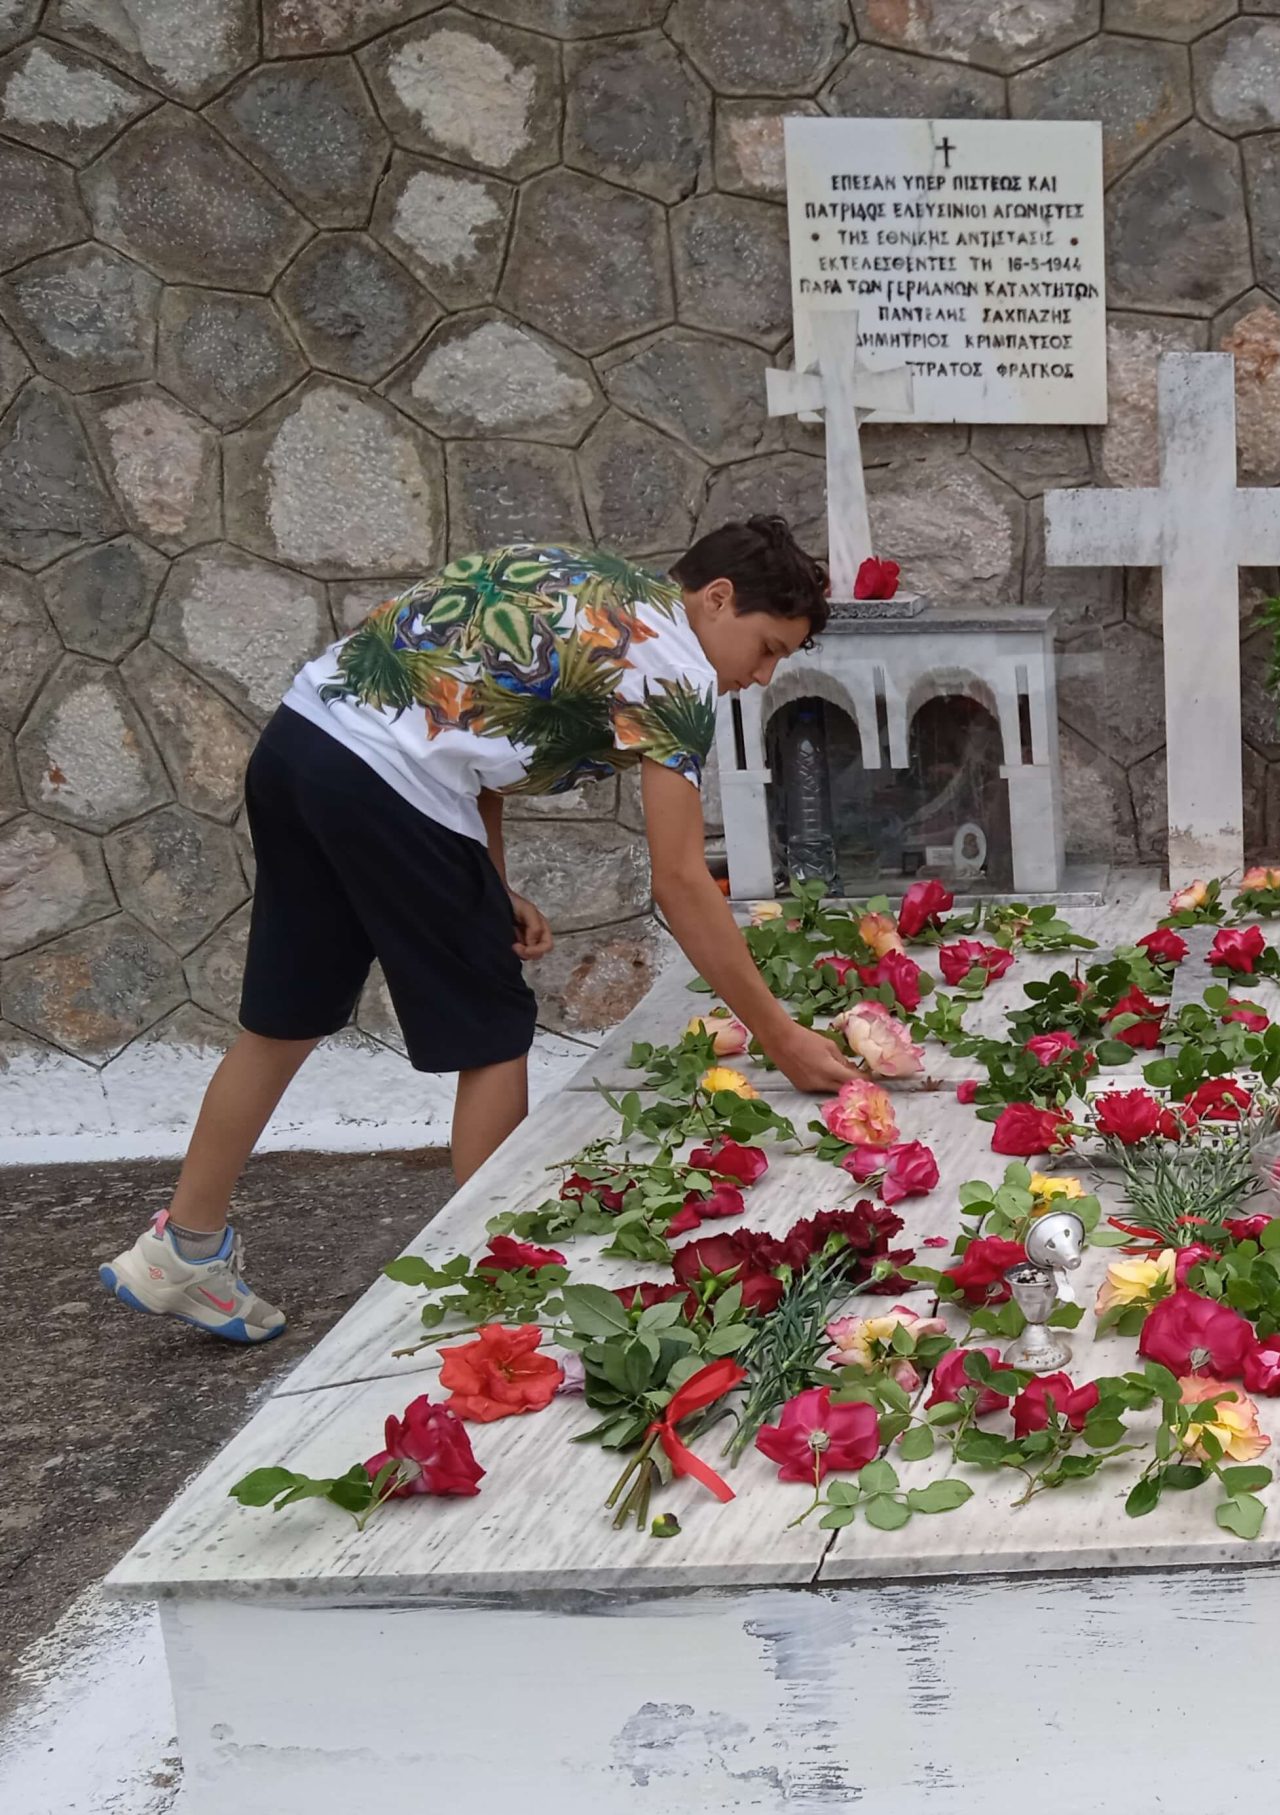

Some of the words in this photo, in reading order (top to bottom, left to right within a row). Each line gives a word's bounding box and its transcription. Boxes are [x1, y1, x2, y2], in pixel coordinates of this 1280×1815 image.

[831, 175, 896, 192] ΕΠΕΣΑΝ
[903, 175, 945, 191] ΥΠΕΡ
[953, 175, 1022, 191] ΠΙΣΤΕΩΣ
[1028, 176, 1057, 191] ΚΑΙ
[805, 203, 885, 222] ΠΑΤΡΙΔΟΣ
[893, 203, 987, 219] ΕΛΕΥΣΙΝΙΟΙ
[993, 204, 1084, 219] ΑΓΩΝΙΣΤΕΣ
[838, 230, 869, 246] ΤΗΣ
[877, 231, 950, 247] ΕΘΝΙΚΗΣ
[819, 257, 957, 272] ΕΚΤΕΛΕΣΘΕΝΤΕΣ
[970, 256, 992, 271] ΤΗ
[1008, 257, 1082, 272] 16-5-1944
[800, 279, 842, 295] ΠΑΡΑ
[847, 280, 882, 294] ΤΩΝ
[887, 280, 979, 302] ΓΕΡΜΑΝΩΝ
[879, 306, 966, 323] ΠΑΝΤΕΛΗΣ
[982, 308, 1072, 324] ΣΑΧΠΑΖΗΣ
[997, 363, 1074, 379] ΦΡΑΓΚΟΣ
